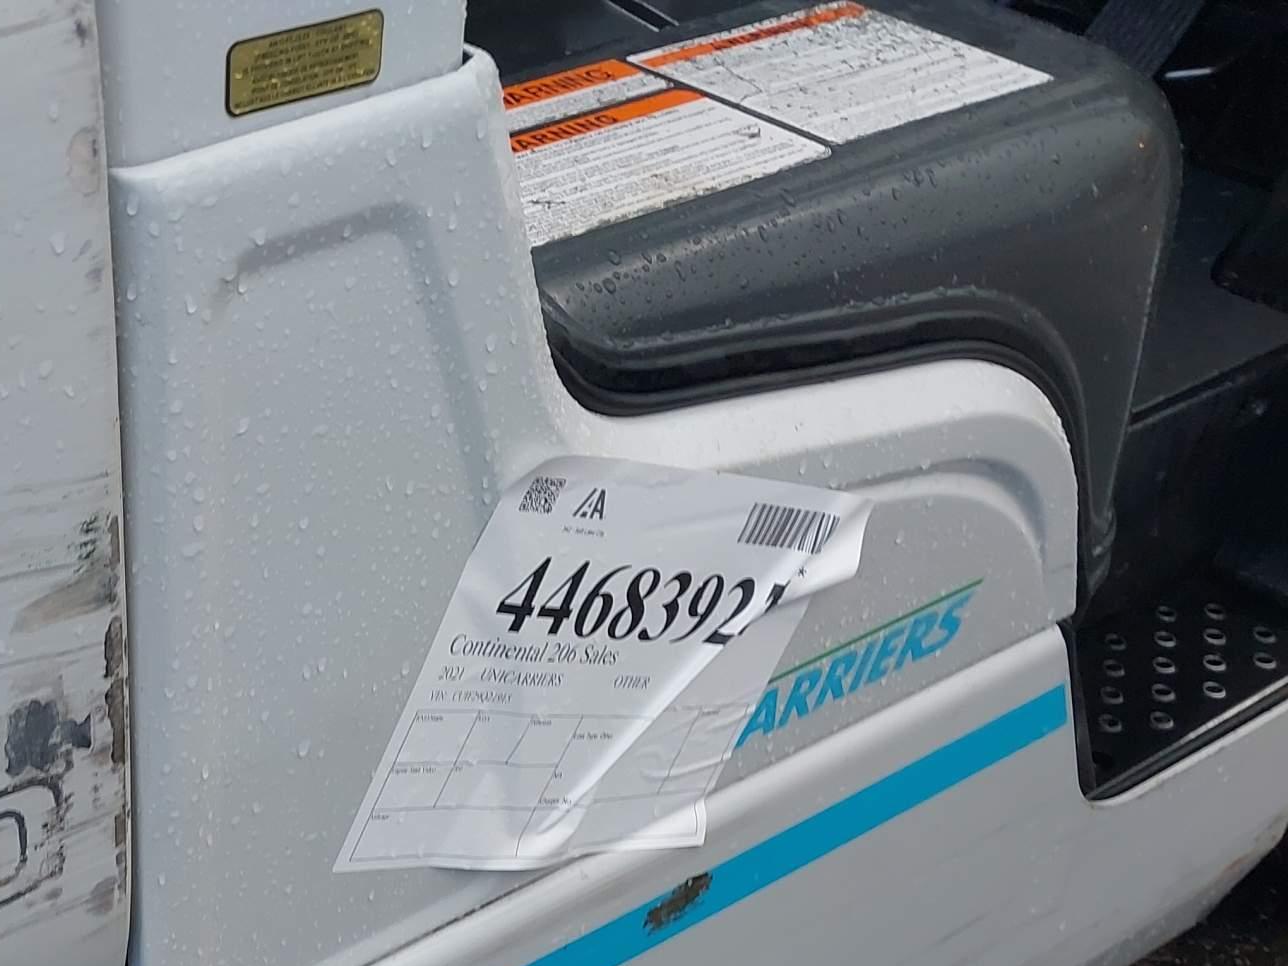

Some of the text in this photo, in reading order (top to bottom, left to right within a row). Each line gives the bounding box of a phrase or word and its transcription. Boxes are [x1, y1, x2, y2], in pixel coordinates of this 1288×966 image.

[511, 113, 618, 153] ARNING
[449, 633, 620, 666] Continental 206 Sales
[480, 667, 565, 688] UNICARRIERS
[734, 588, 978, 749] ARRIERS
